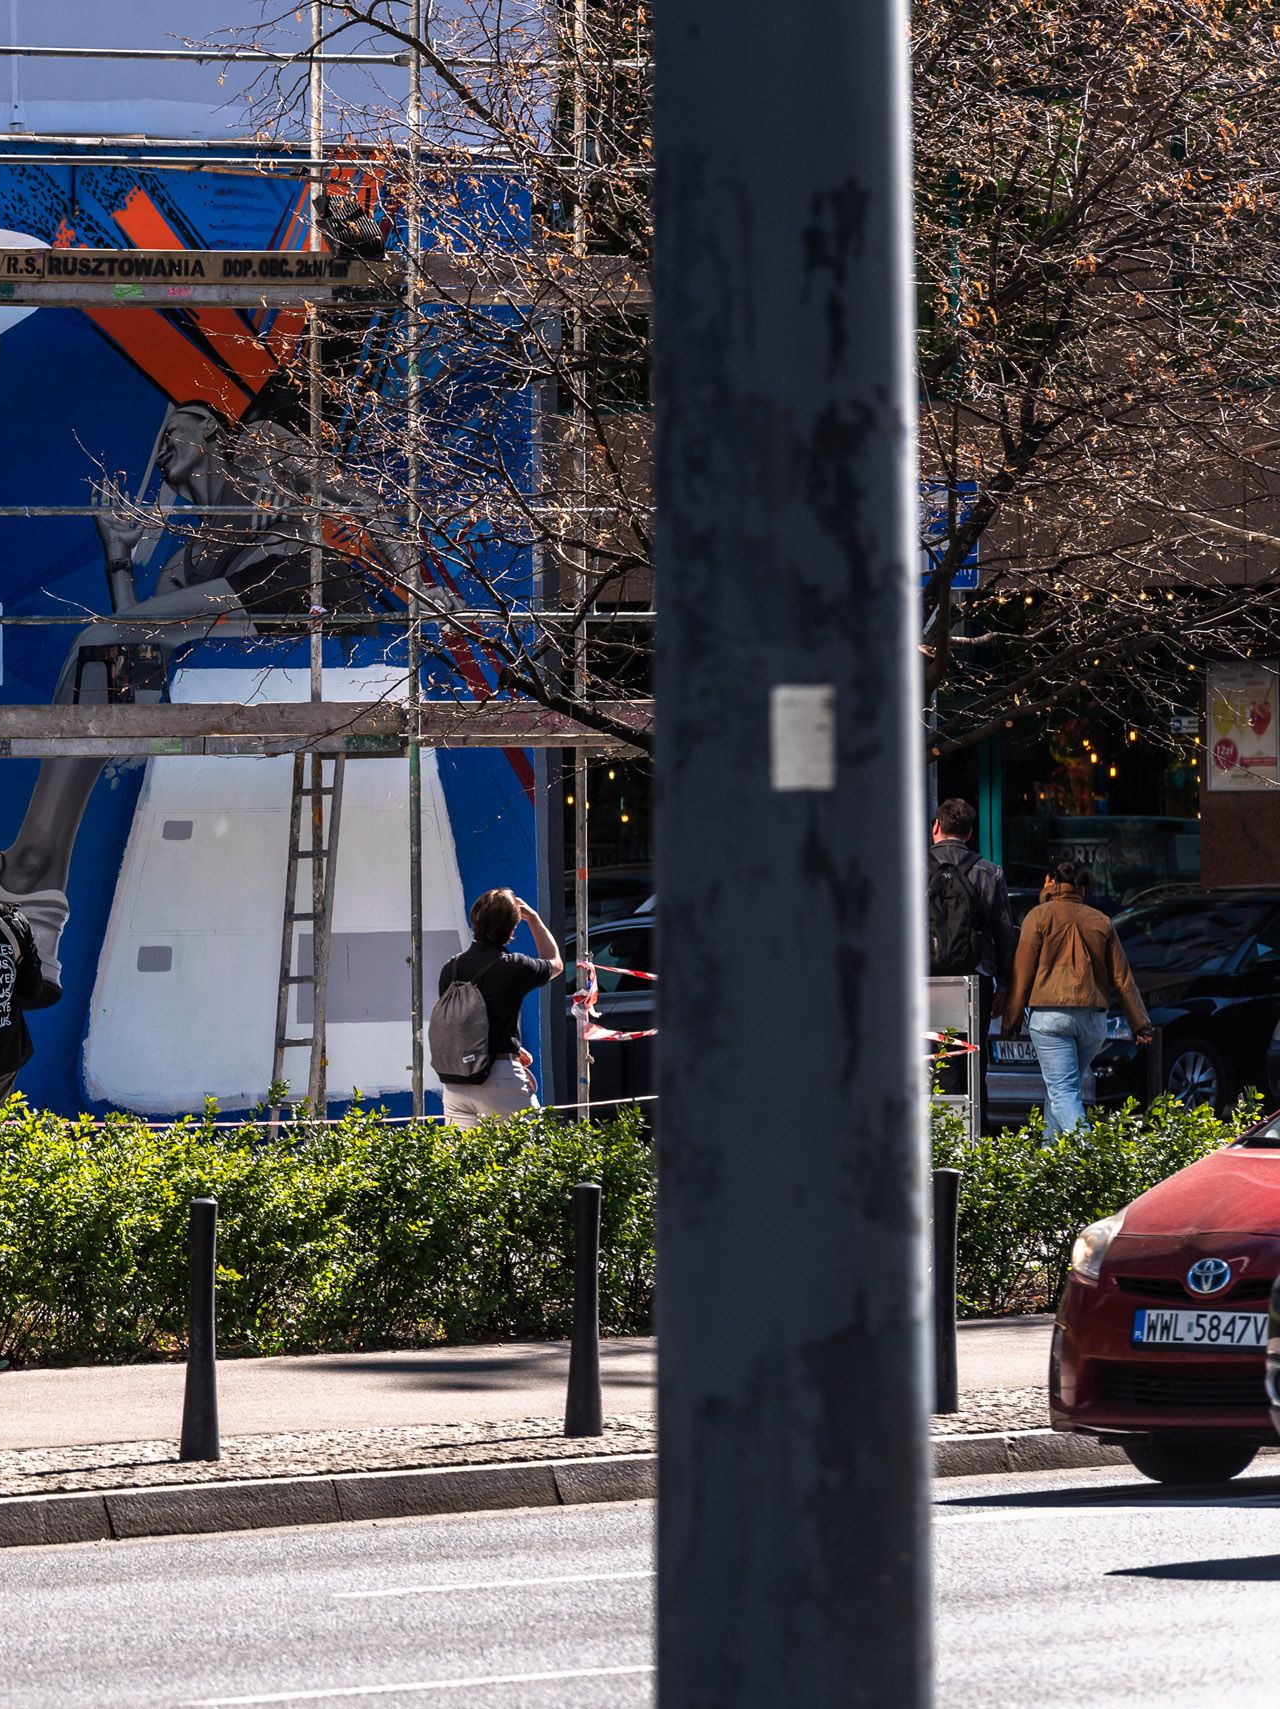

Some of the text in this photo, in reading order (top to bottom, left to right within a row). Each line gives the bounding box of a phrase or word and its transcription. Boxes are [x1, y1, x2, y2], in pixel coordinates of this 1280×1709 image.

[6, 258, 41, 275] R.S.
[47, 257, 206, 278] RUSZTOWANIA
[222, 258, 257, 278] DOP.
[1145, 1312, 1268, 1345] WWL 5847V
